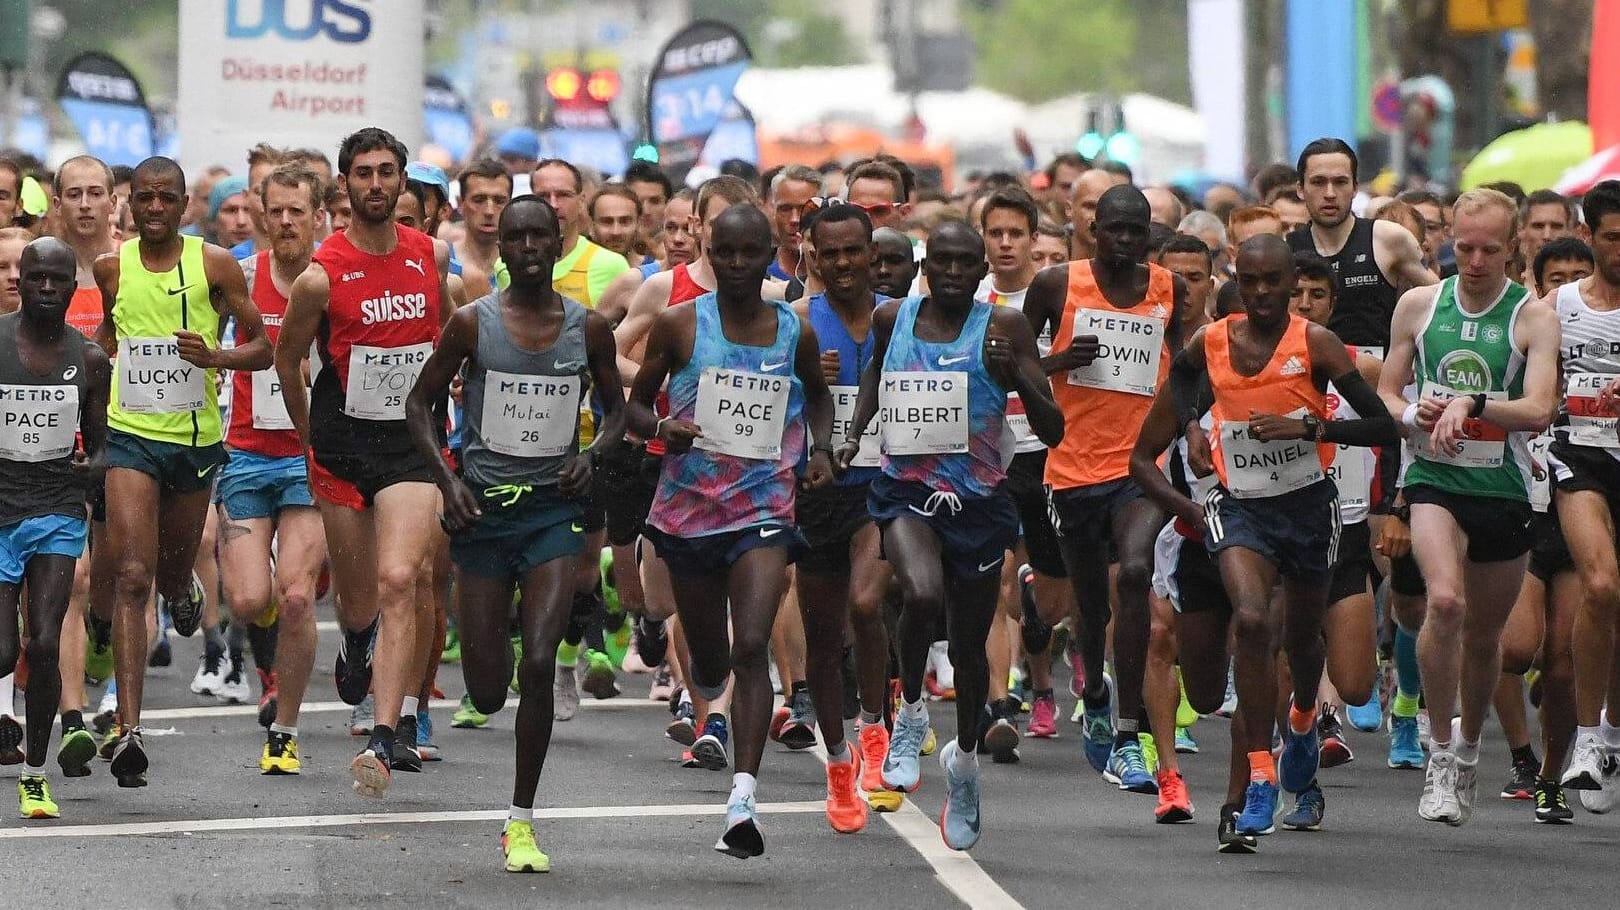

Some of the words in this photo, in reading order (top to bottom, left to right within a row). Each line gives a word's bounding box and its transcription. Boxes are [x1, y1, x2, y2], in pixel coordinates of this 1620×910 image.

[225, 0, 371, 43] DUS
[222, 58, 367, 83] Düsseldorf
[271, 89, 365, 117] Airport
[350, 270, 365, 280] UBS
[1344, 274, 1378, 285] ENGELS
[1089, 316, 1153, 336] METRO
[129, 344, 178, 356] METR
[1097, 344, 1151, 365] DWIN
[1569, 343, 1586, 360] LT
[365, 351, 425, 365] METRO
[128, 367, 192, 385] LUCKY
[1112, 365, 1121, 377] 3
[1446, 369, 1482, 387] EAM
[500, 381, 570, 396] METRO
[715, 372, 782, 393] METRO
[885, 379, 953, 392] METRO
[0, 389, 65, 401] METRO
[156, 388, 165, 400] 5
[384, 395, 401, 407] 25
[718, 399, 773, 421] PACE
[880, 407, 963, 424] GILBERT
[5, 412, 59, 428] PACE
[520, 430, 539, 442] 26
[734, 423, 754, 437] 99
[912, 428, 921, 440] 7
[22, 432, 40, 444] 85
[1233, 443, 1308, 469] DANIEL
[1269, 471, 1279, 481] 4
[1326, 466, 1342, 480] RI
